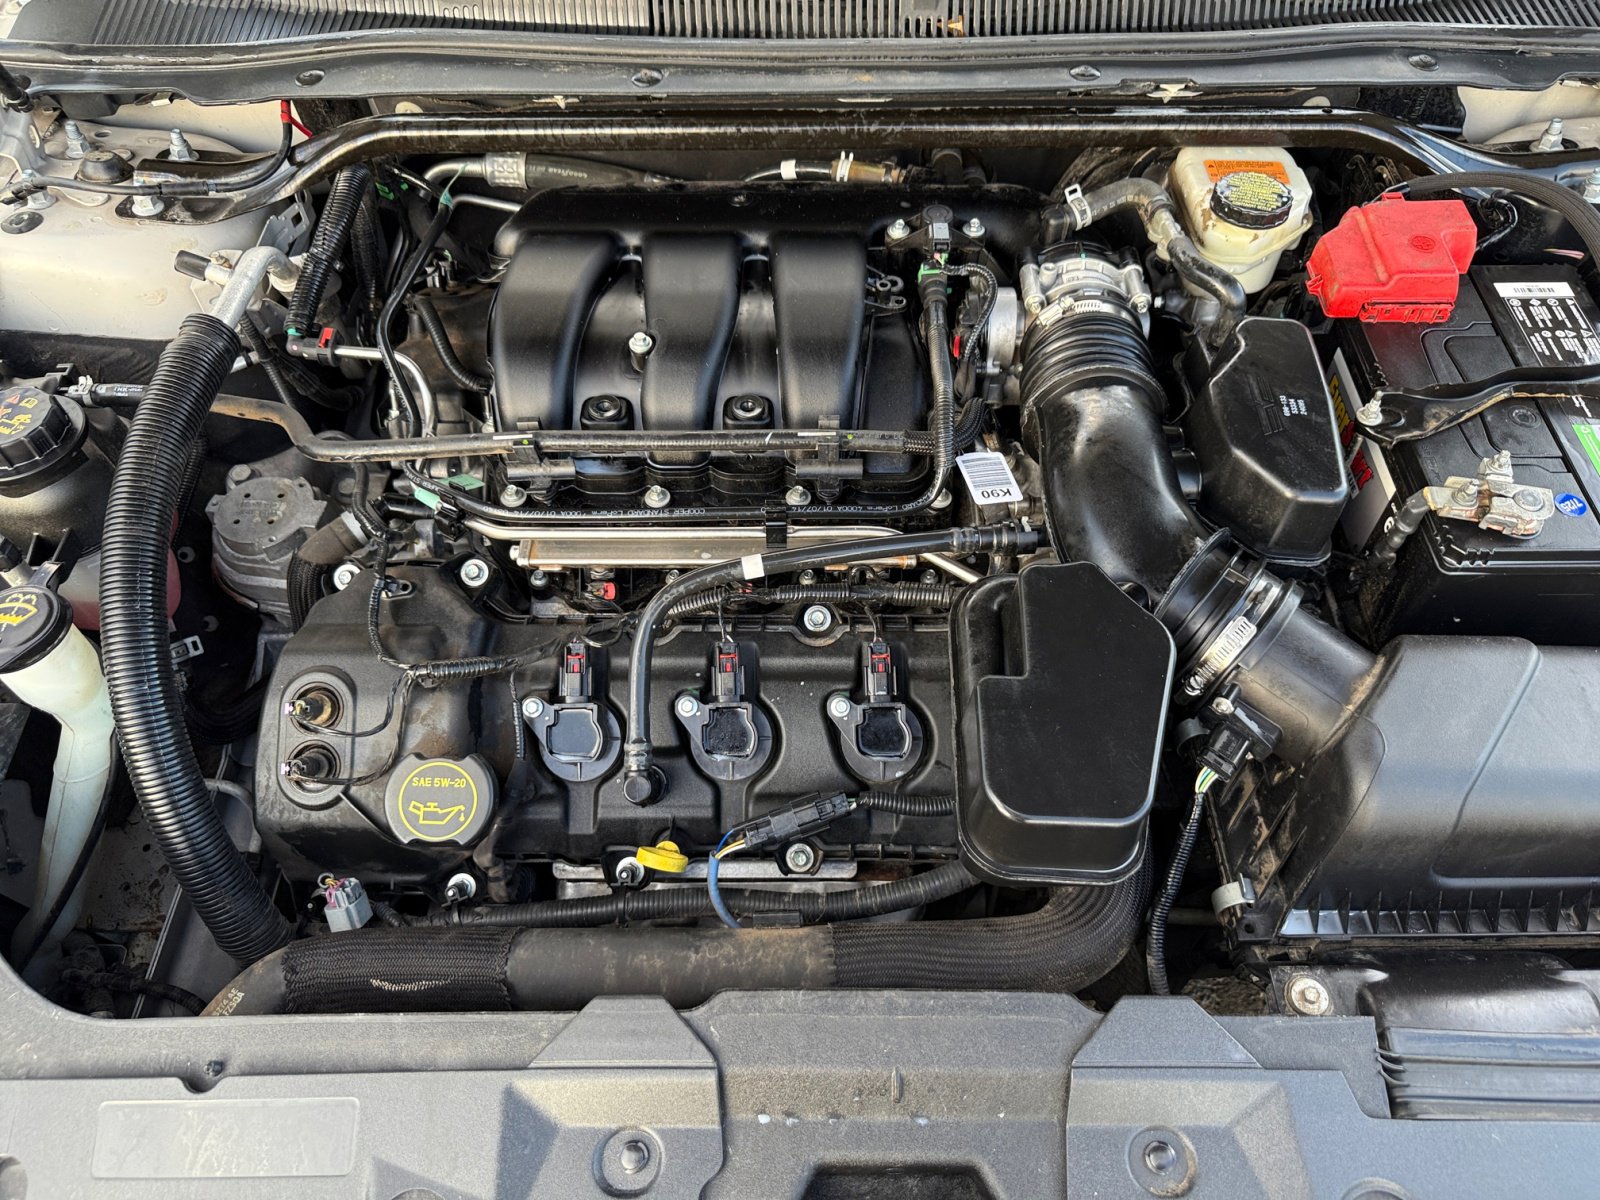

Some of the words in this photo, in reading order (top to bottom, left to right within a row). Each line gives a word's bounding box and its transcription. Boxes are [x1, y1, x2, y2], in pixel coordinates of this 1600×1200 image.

[981, 488, 1012, 498] K90
[1560, 498, 1583, 512] 7/25
[627, 509, 670, 517] STANDARD
[412, 777, 432, 787] SAE
[433, 778, 467, 788] 5W-20
